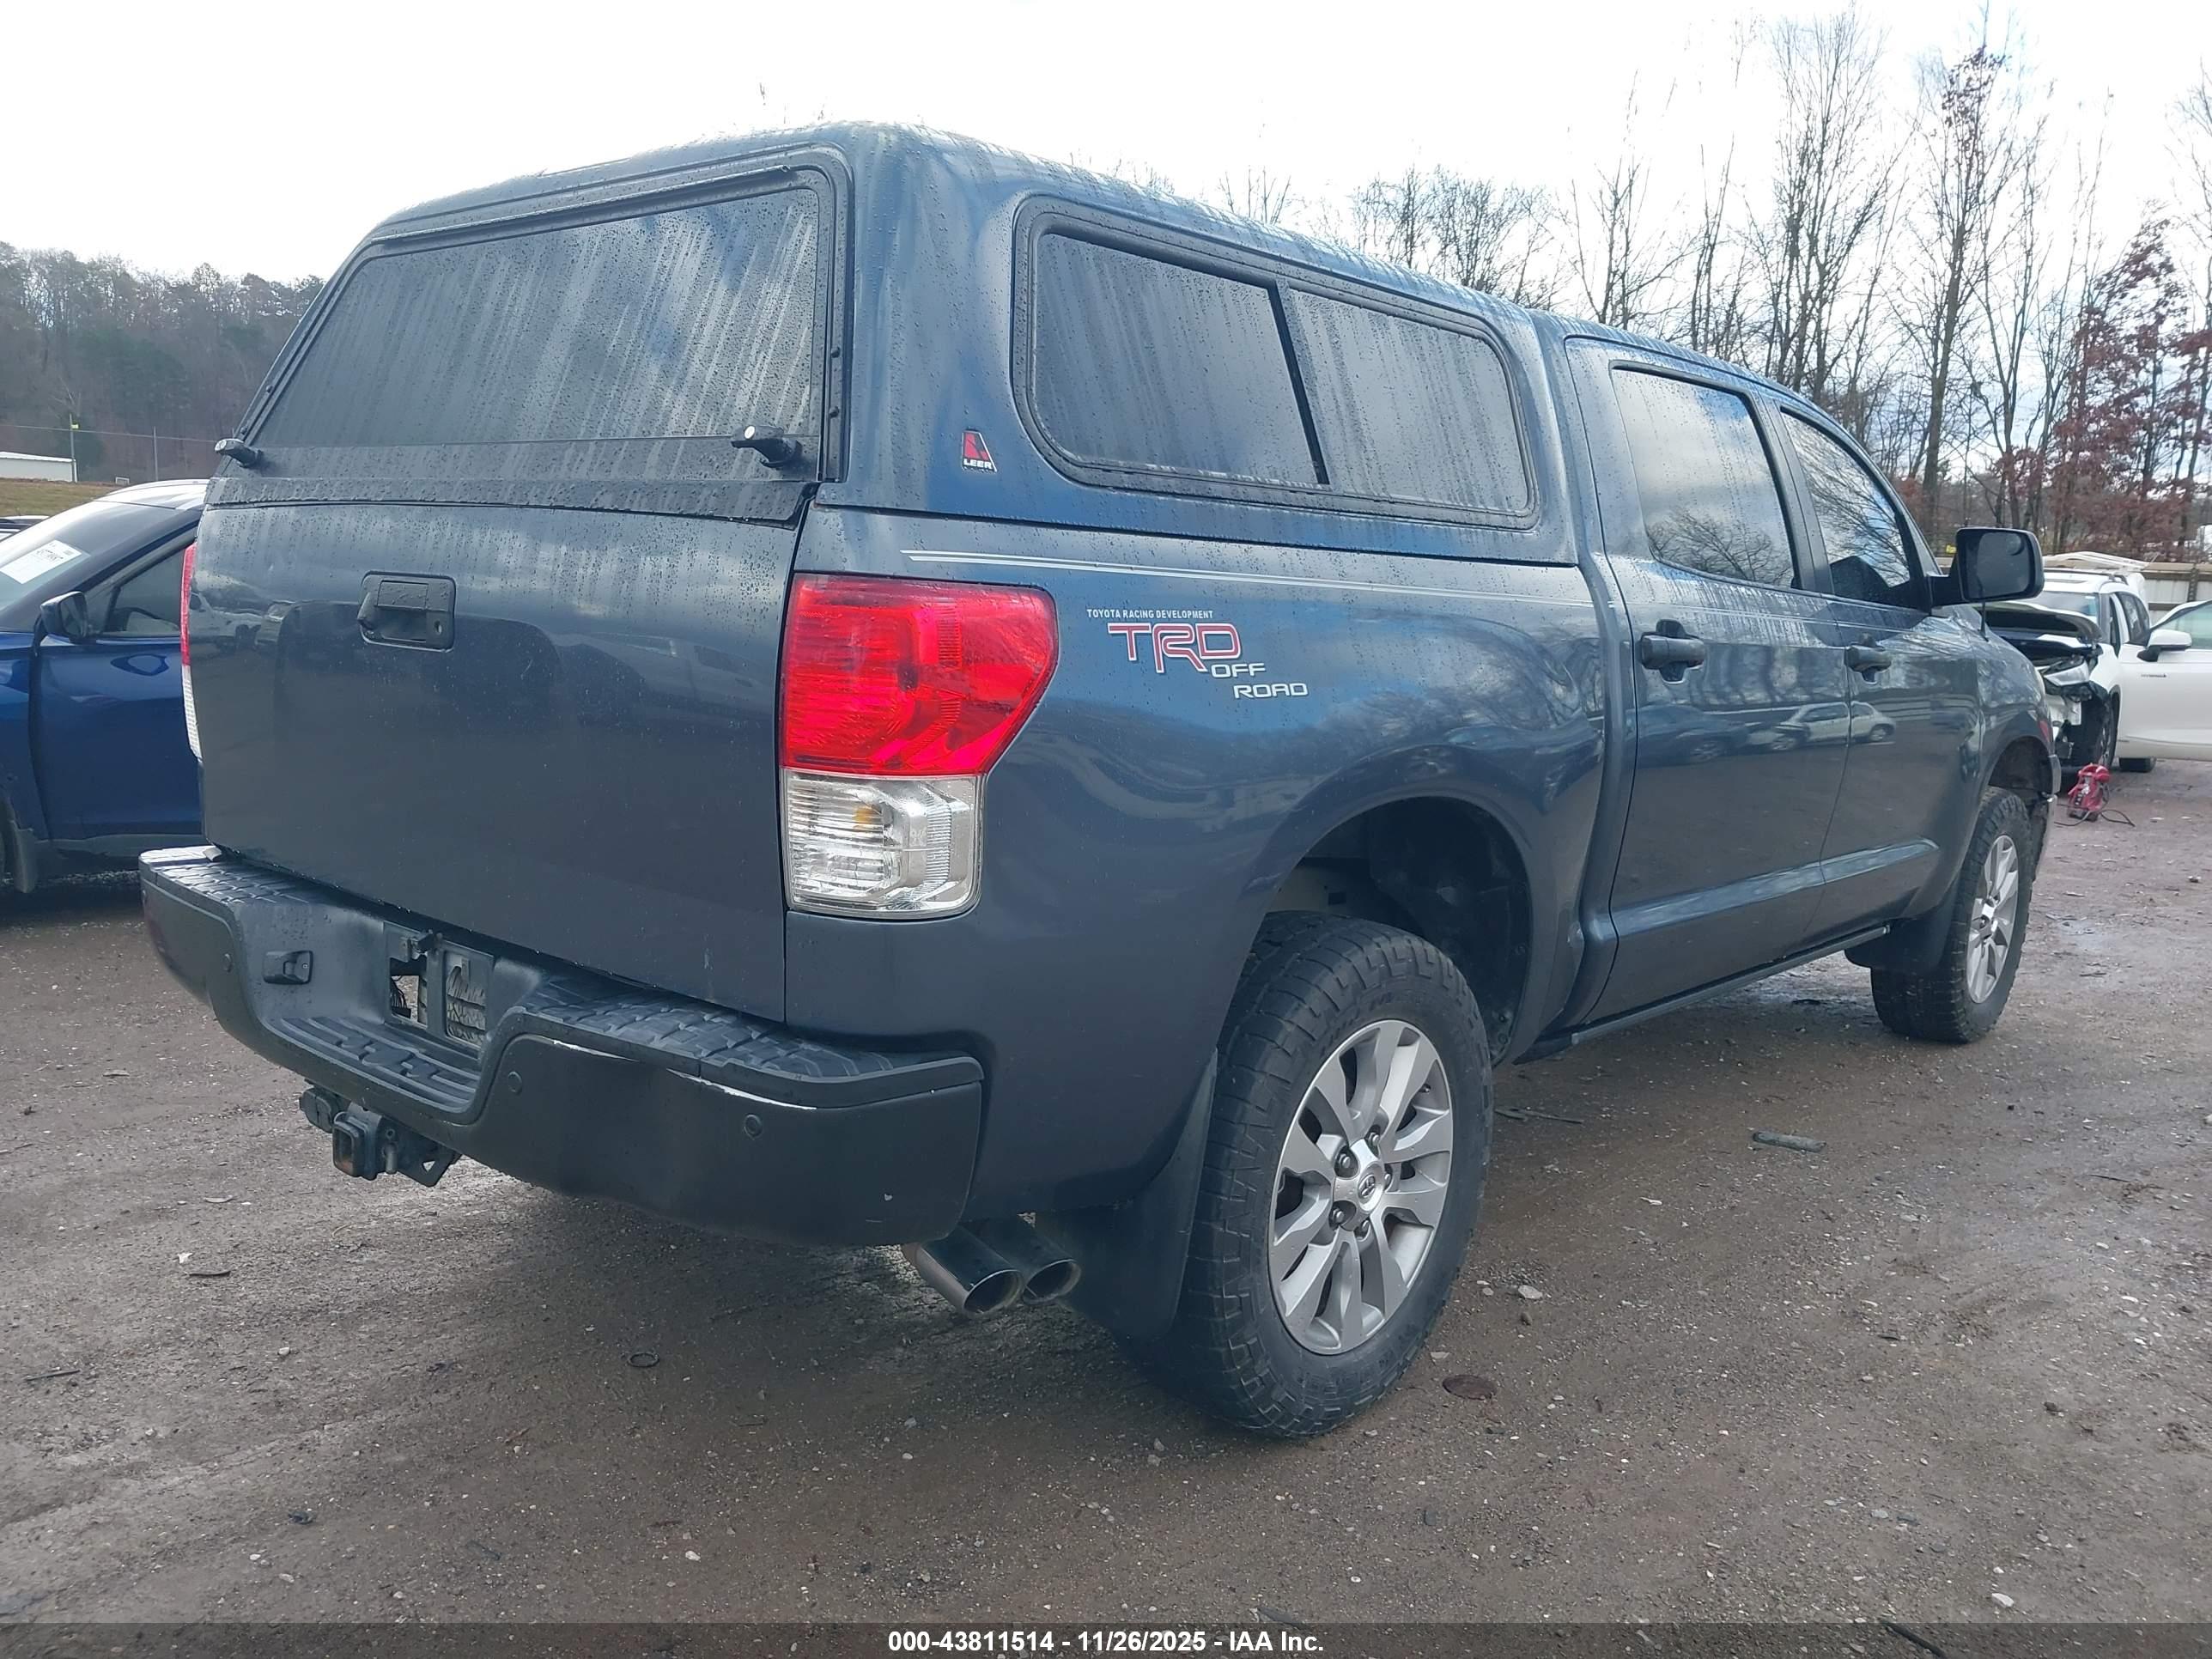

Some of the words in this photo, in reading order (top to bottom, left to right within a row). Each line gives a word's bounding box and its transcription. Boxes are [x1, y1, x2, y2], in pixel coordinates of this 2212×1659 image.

[963, 458, 993, 470] LEER
[1086, 608, 1121, 619] TOYOTA
[1122, 609, 1154, 619] RACING
[1156, 610, 1213, 619] DEVELOPMENT
[1107, 623, 1242, 674] TRD
[1211, 662, 1267, 678] OFF
[1233, 683, 1309, 699] ROAD
